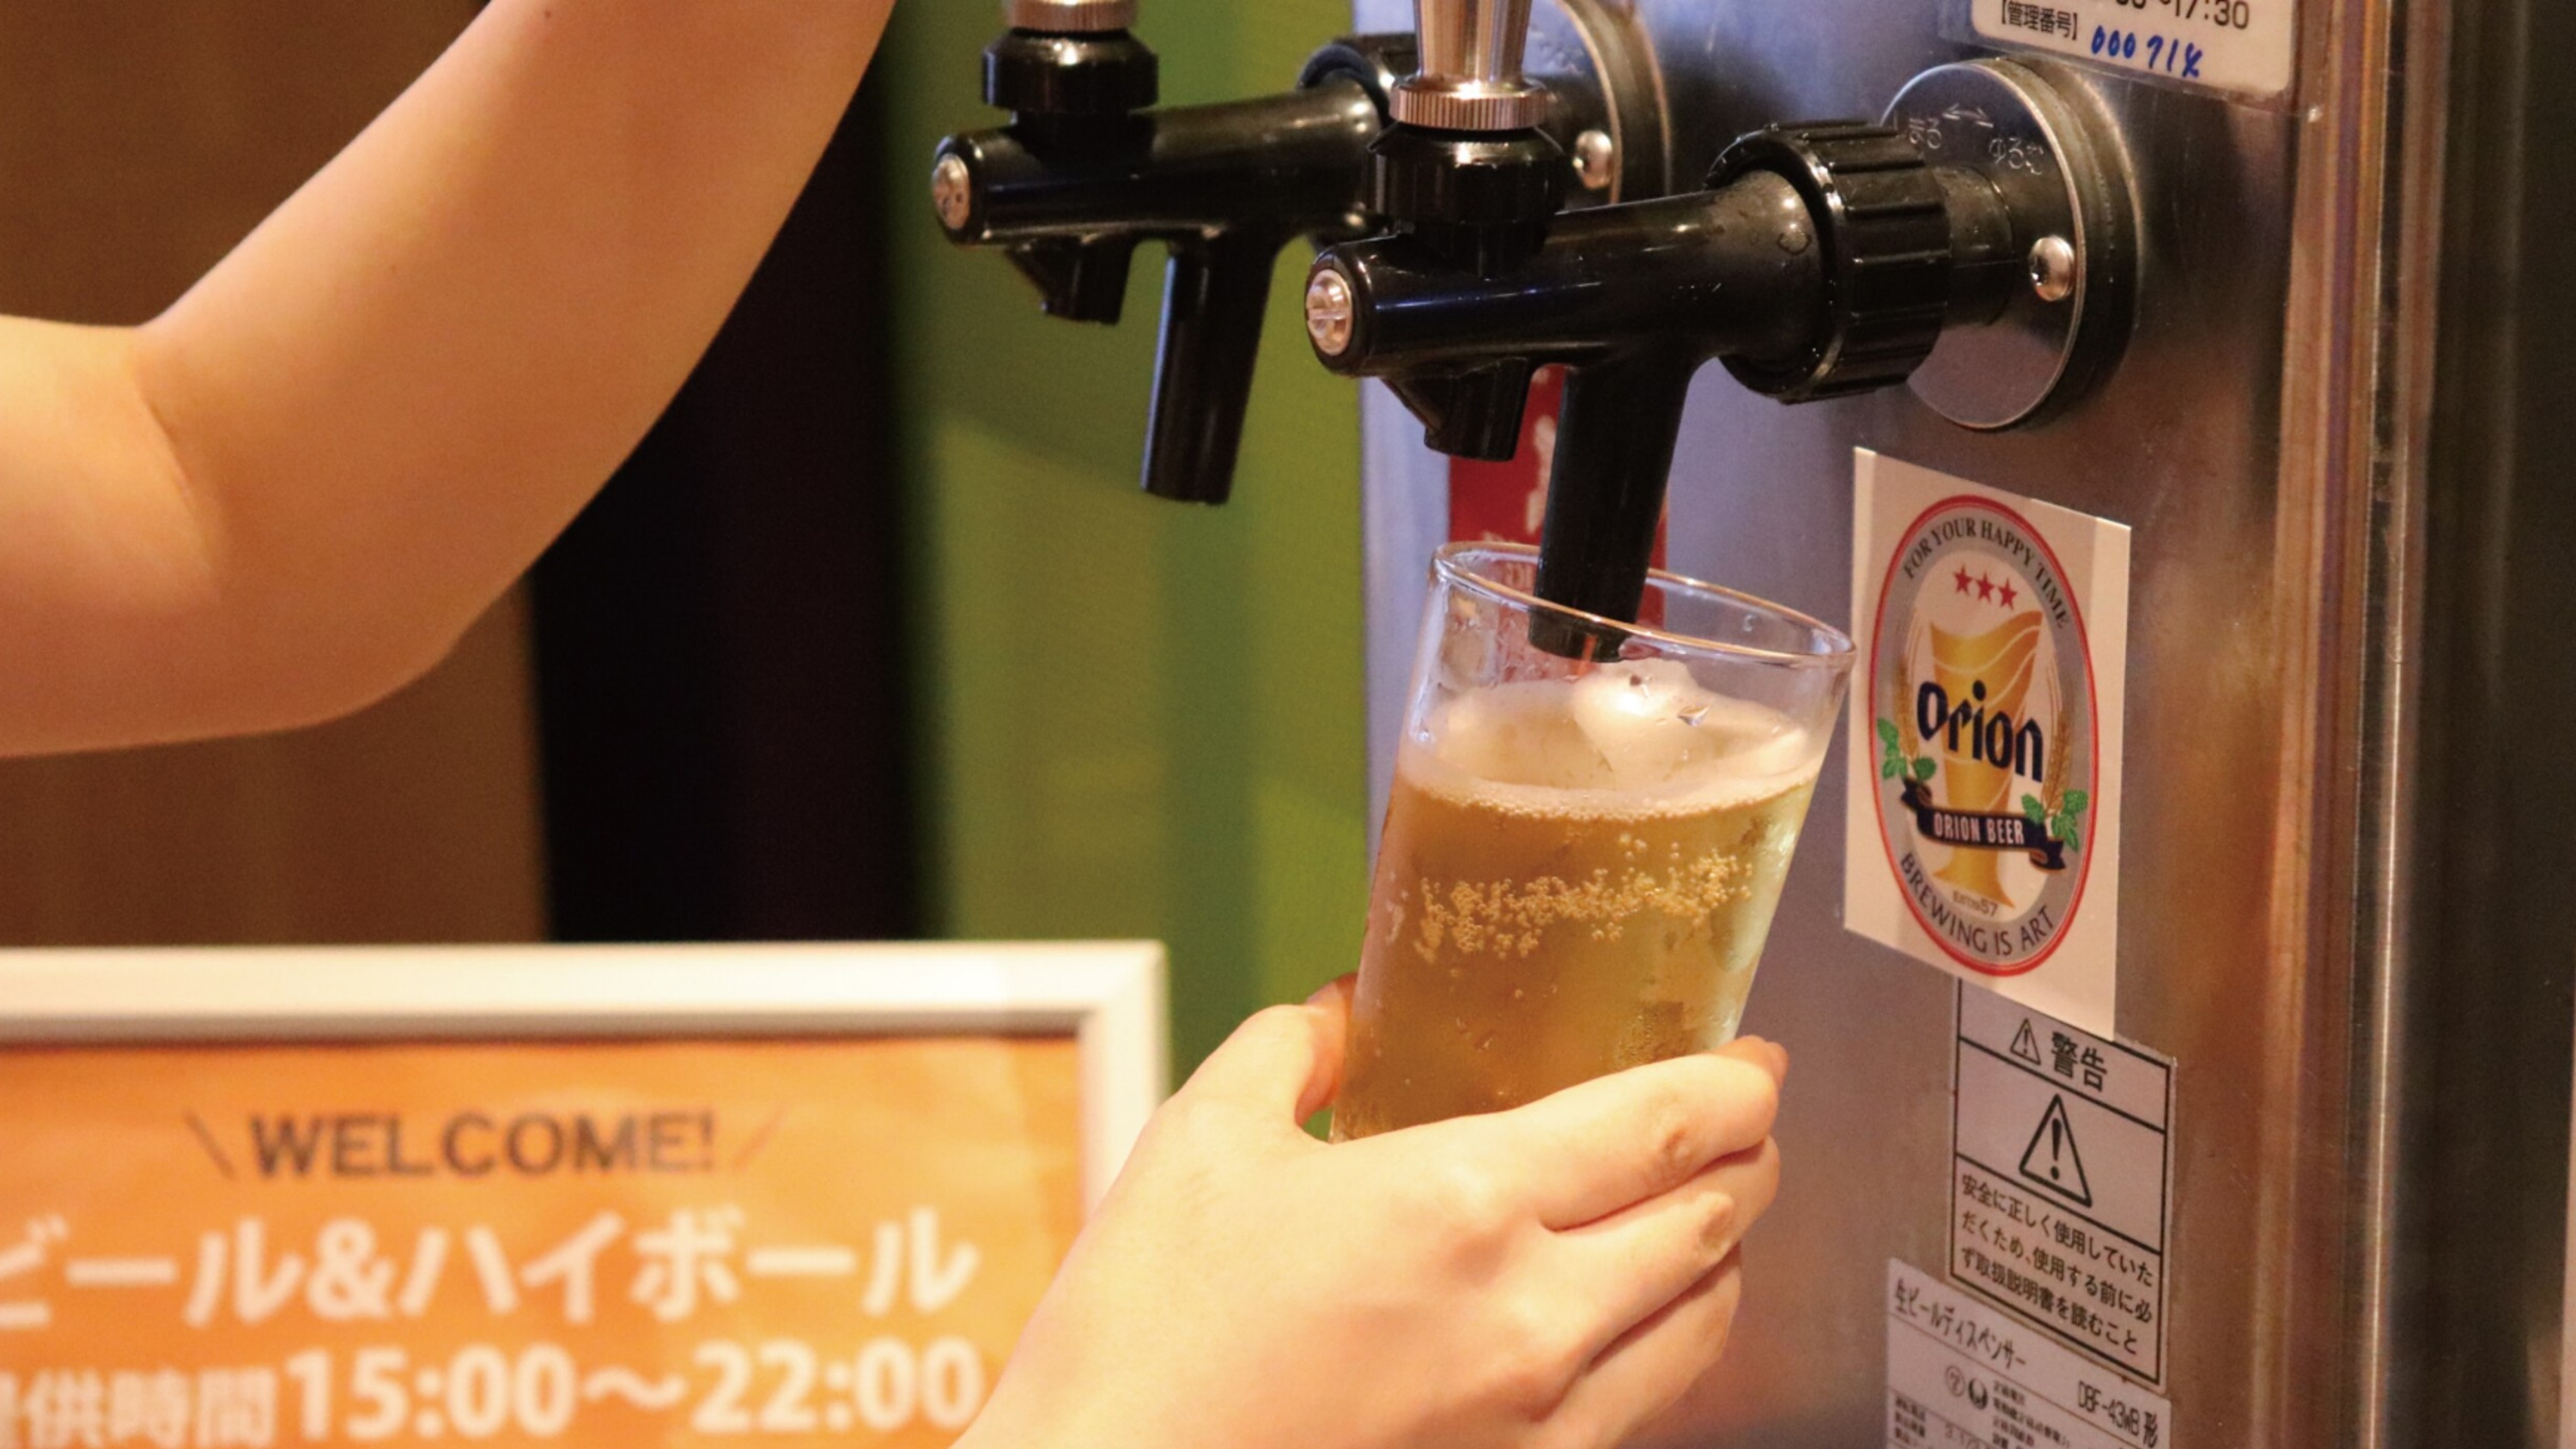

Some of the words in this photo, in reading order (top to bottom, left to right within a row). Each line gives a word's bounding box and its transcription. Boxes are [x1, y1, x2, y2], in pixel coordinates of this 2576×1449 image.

[1903, 538, 1933, 580] FOR
[1930, 518, 1977, 546] YOUR
[1981, 519, 2036, 567] HAPPY
[2033, 565, 2069, 629] TIME
[1934, 811, 1981, 841] ORION
[1986, 817, 2025, 845] BEER
[1899, 852, 1988, 954] BREWING
[1995, 933, 2013, 956] IS
[2020, 904, 2054, 950] ART
[2050, 1030, 2108, 1093] 警告
[249, 1113, 714, 1177] WELCOME!
[1962, 1173, 2154, 1288] 安全に正しく使用していた
[1962, 1210, 2153, 1324] だくため、使用する前に必
[1961, 1246, 2138, 1355] ず取扱説明書を読むこと
